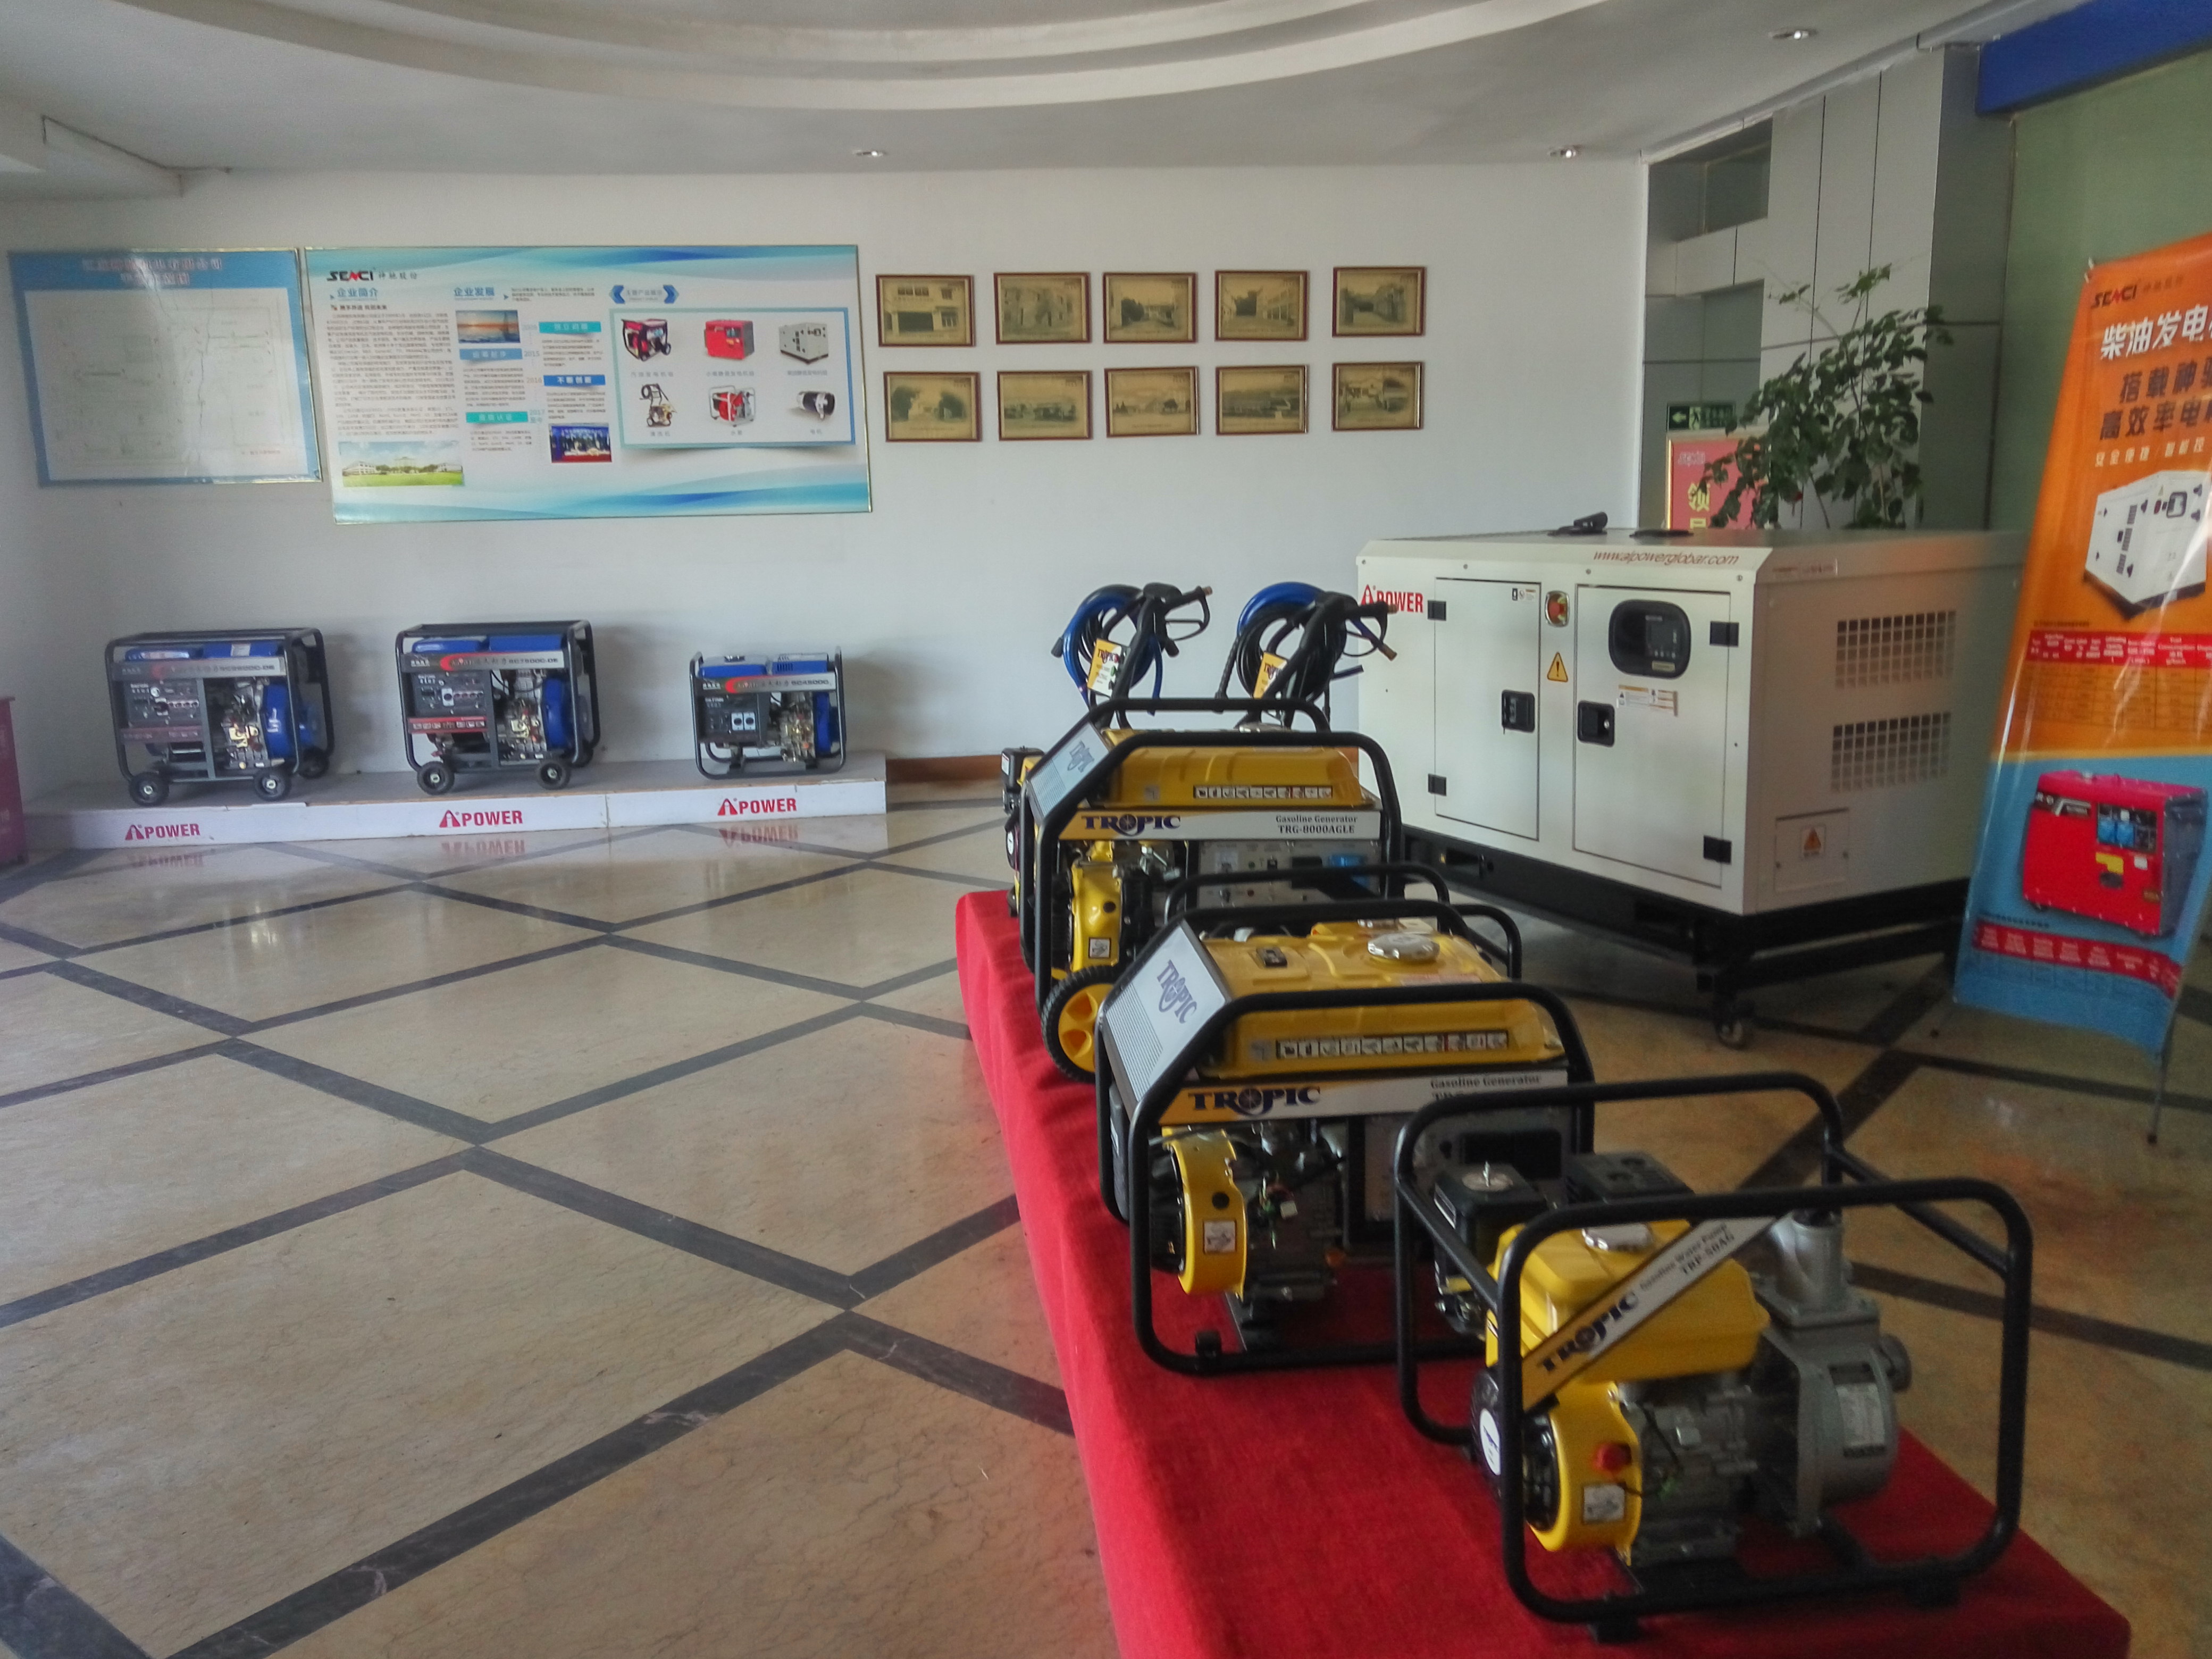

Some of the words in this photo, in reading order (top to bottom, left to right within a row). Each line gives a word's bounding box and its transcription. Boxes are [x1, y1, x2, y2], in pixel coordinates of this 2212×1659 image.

[337, 287, 378, 298] 企业简介
[454, 287, 495, 297] 企业发展
[2100, 304, 2212, 360] 柴油发电
[1082, 814, 1181, 837] TROPIC
[1314, 815, 1358, 823] Generator
[1157, 959, 1197, 1025] TROPIC
[1188, 1086, 1320, 1116] TROPIC
[1537, 1292, 1639, 1371] TROPIC
